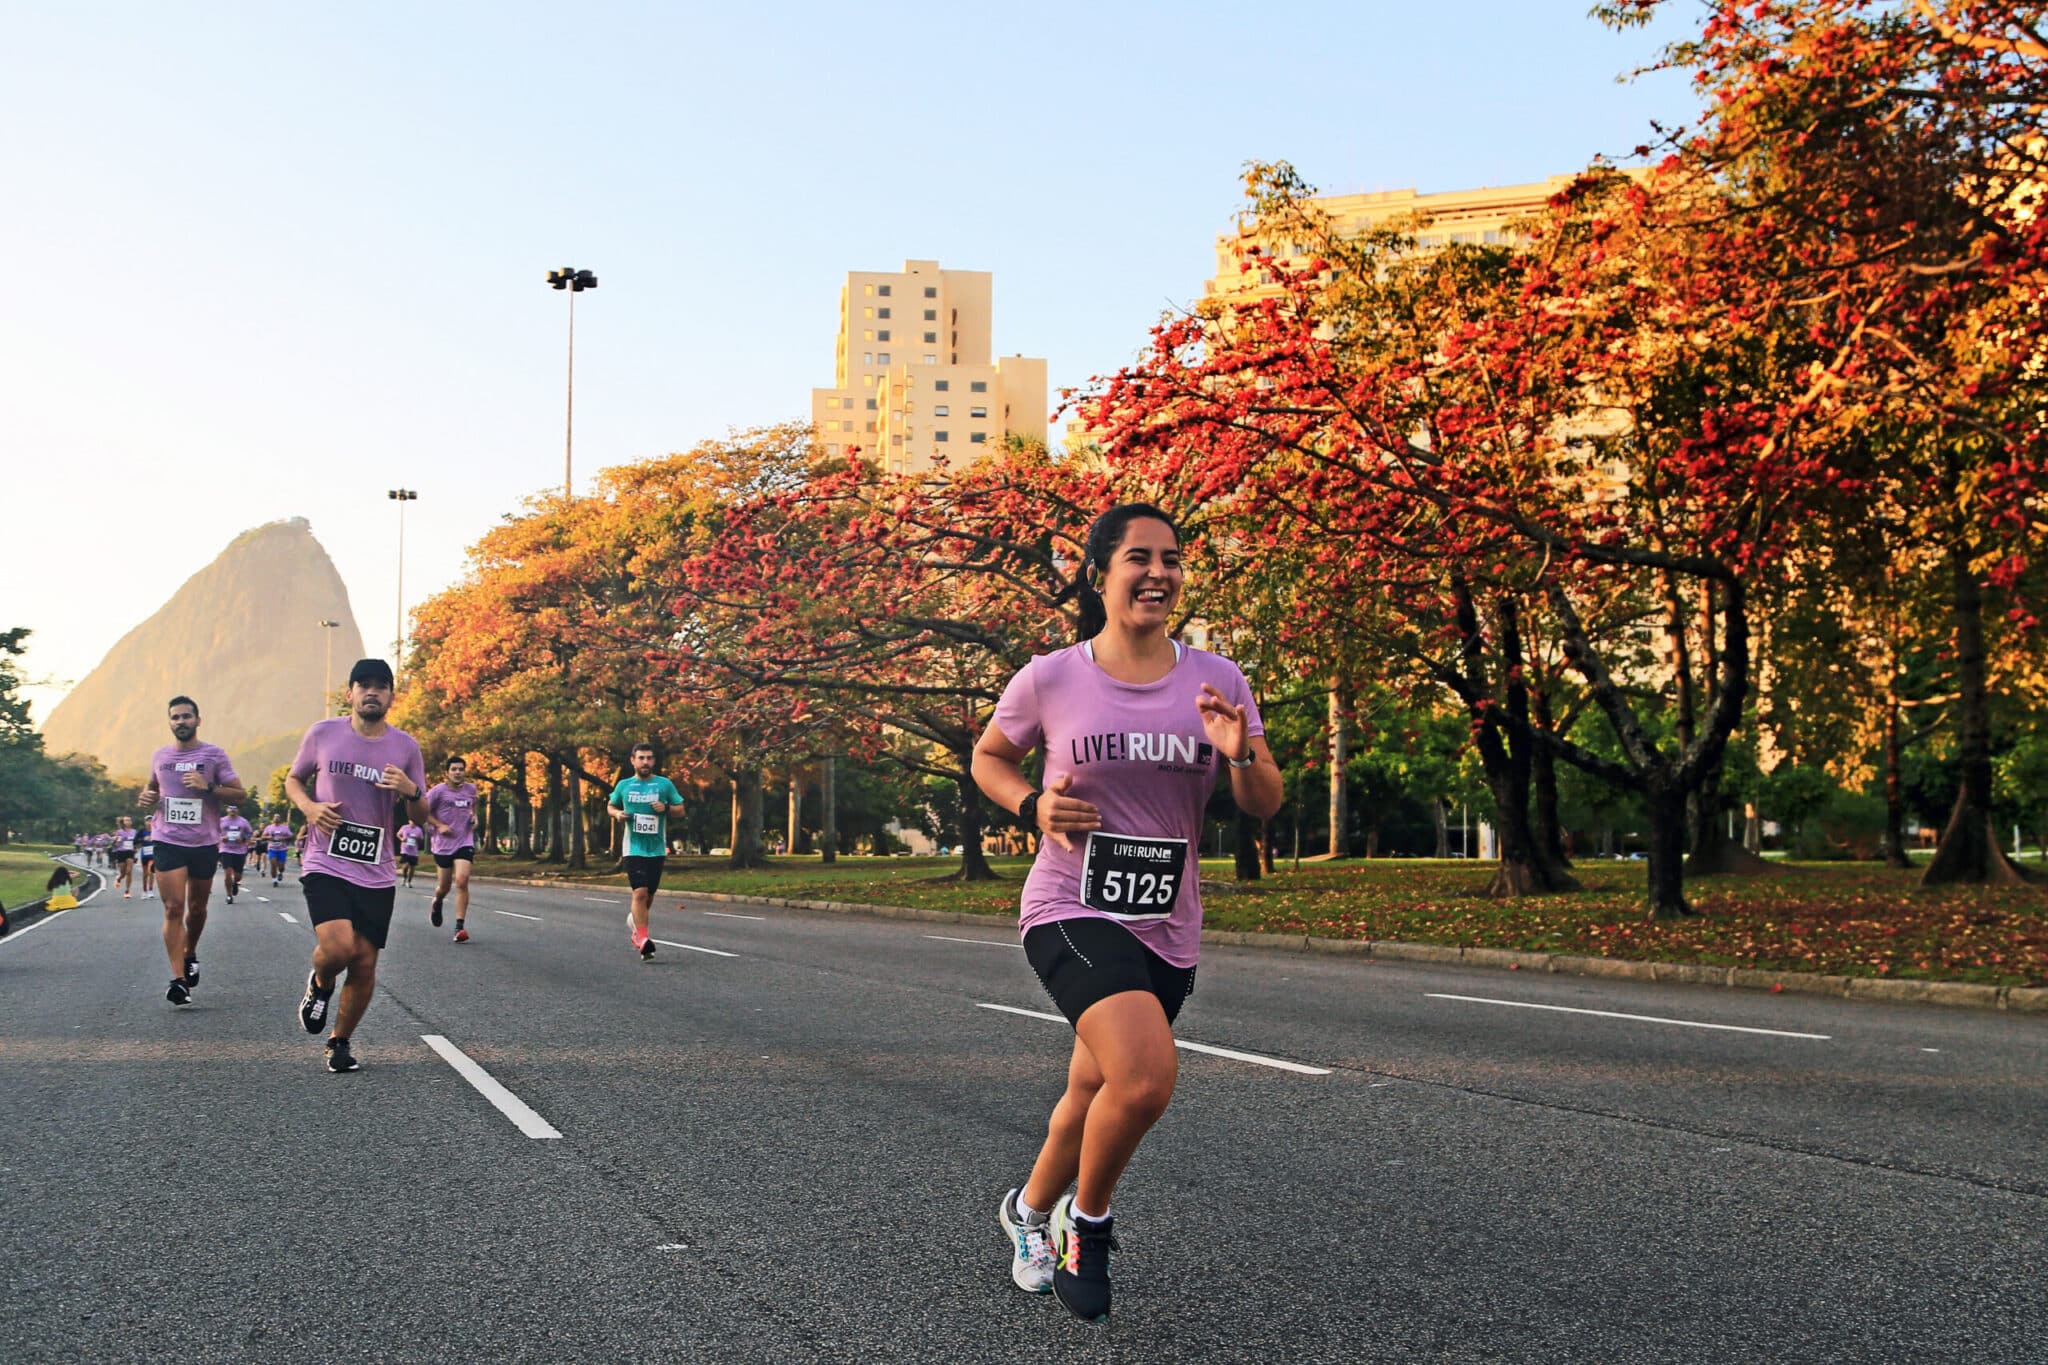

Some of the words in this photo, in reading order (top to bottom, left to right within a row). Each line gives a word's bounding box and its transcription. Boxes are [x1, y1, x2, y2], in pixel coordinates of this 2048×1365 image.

[1072, 732, 1195, 764] LIVE!RUN
[170, 809, 196, 821] 9142
[338, 836, 376, 857] 6012
[1113, 843, 1163, 859] LIVE!RUN
[1102, 870, 1175, 905] 5125
